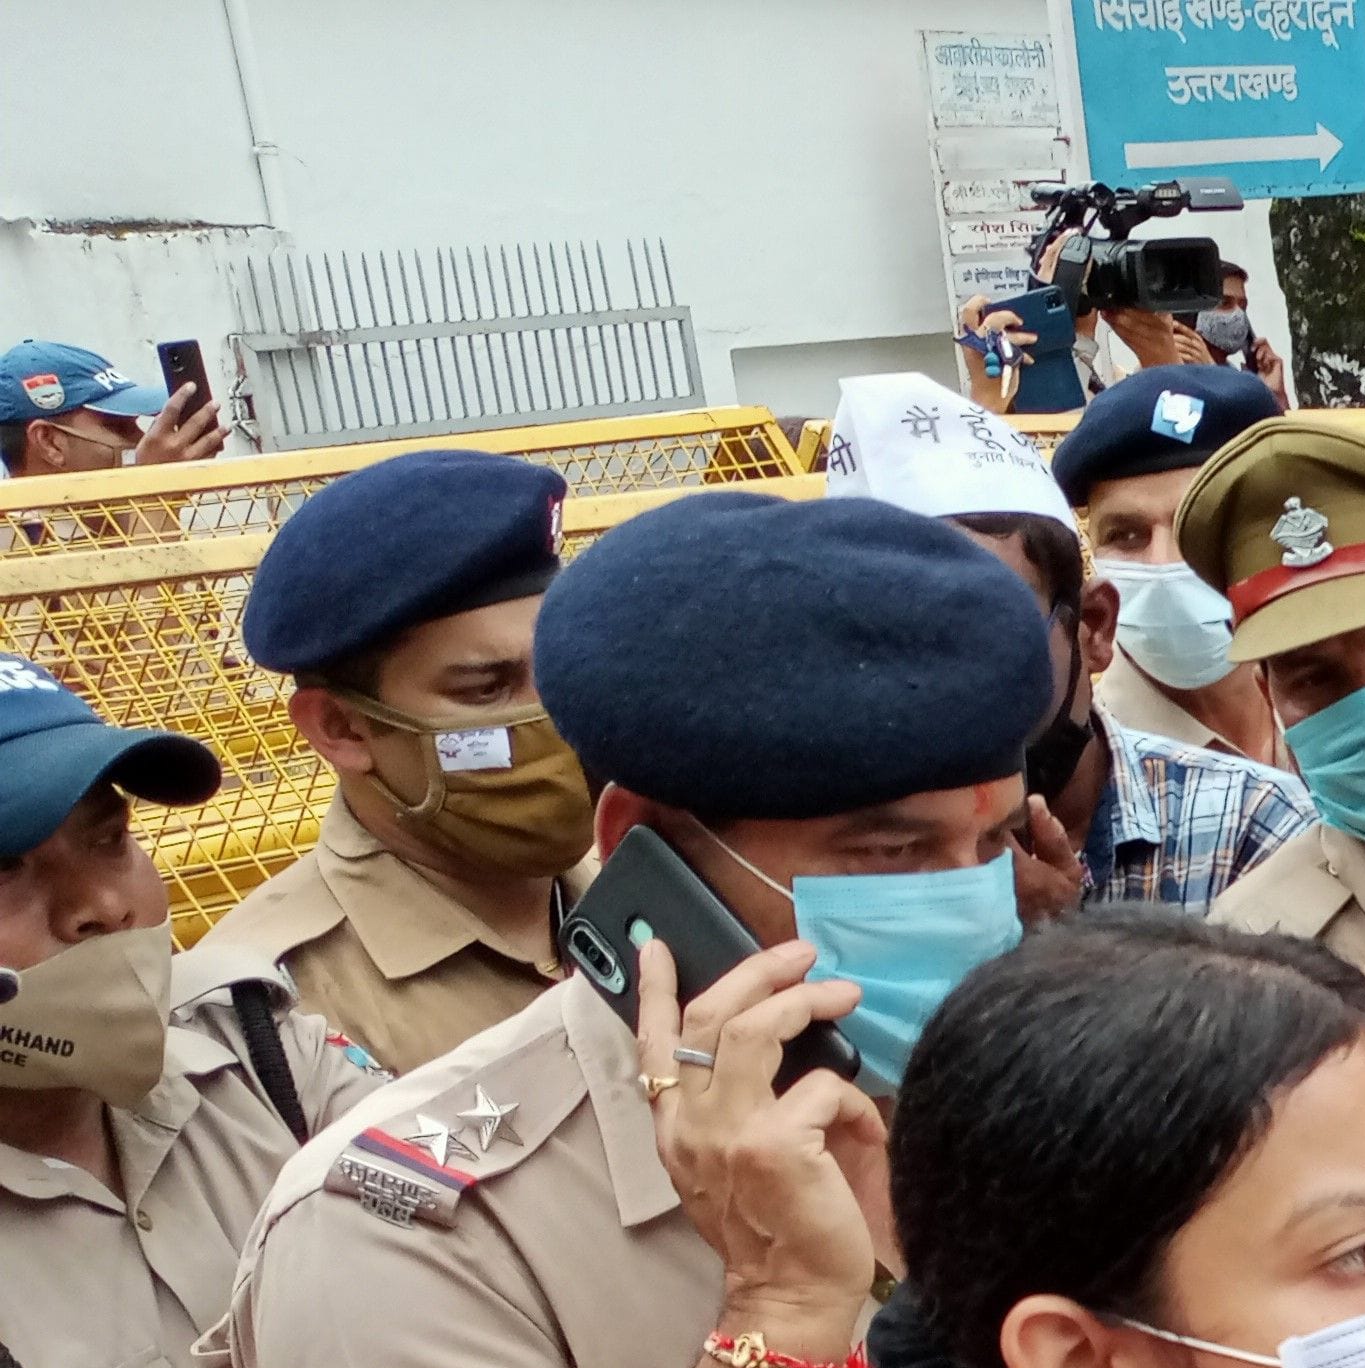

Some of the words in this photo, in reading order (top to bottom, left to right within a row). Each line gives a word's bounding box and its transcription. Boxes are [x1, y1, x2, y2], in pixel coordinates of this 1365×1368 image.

[1094, 0, 1186, 44] सिचाई
[1165, 64, 1297, 105] उत्तराखण्ड
[901, 405, 941, 443] मैं
[0, 1025, 75, 1057] KHAND
[0, 1049, 28, 1068] CE
